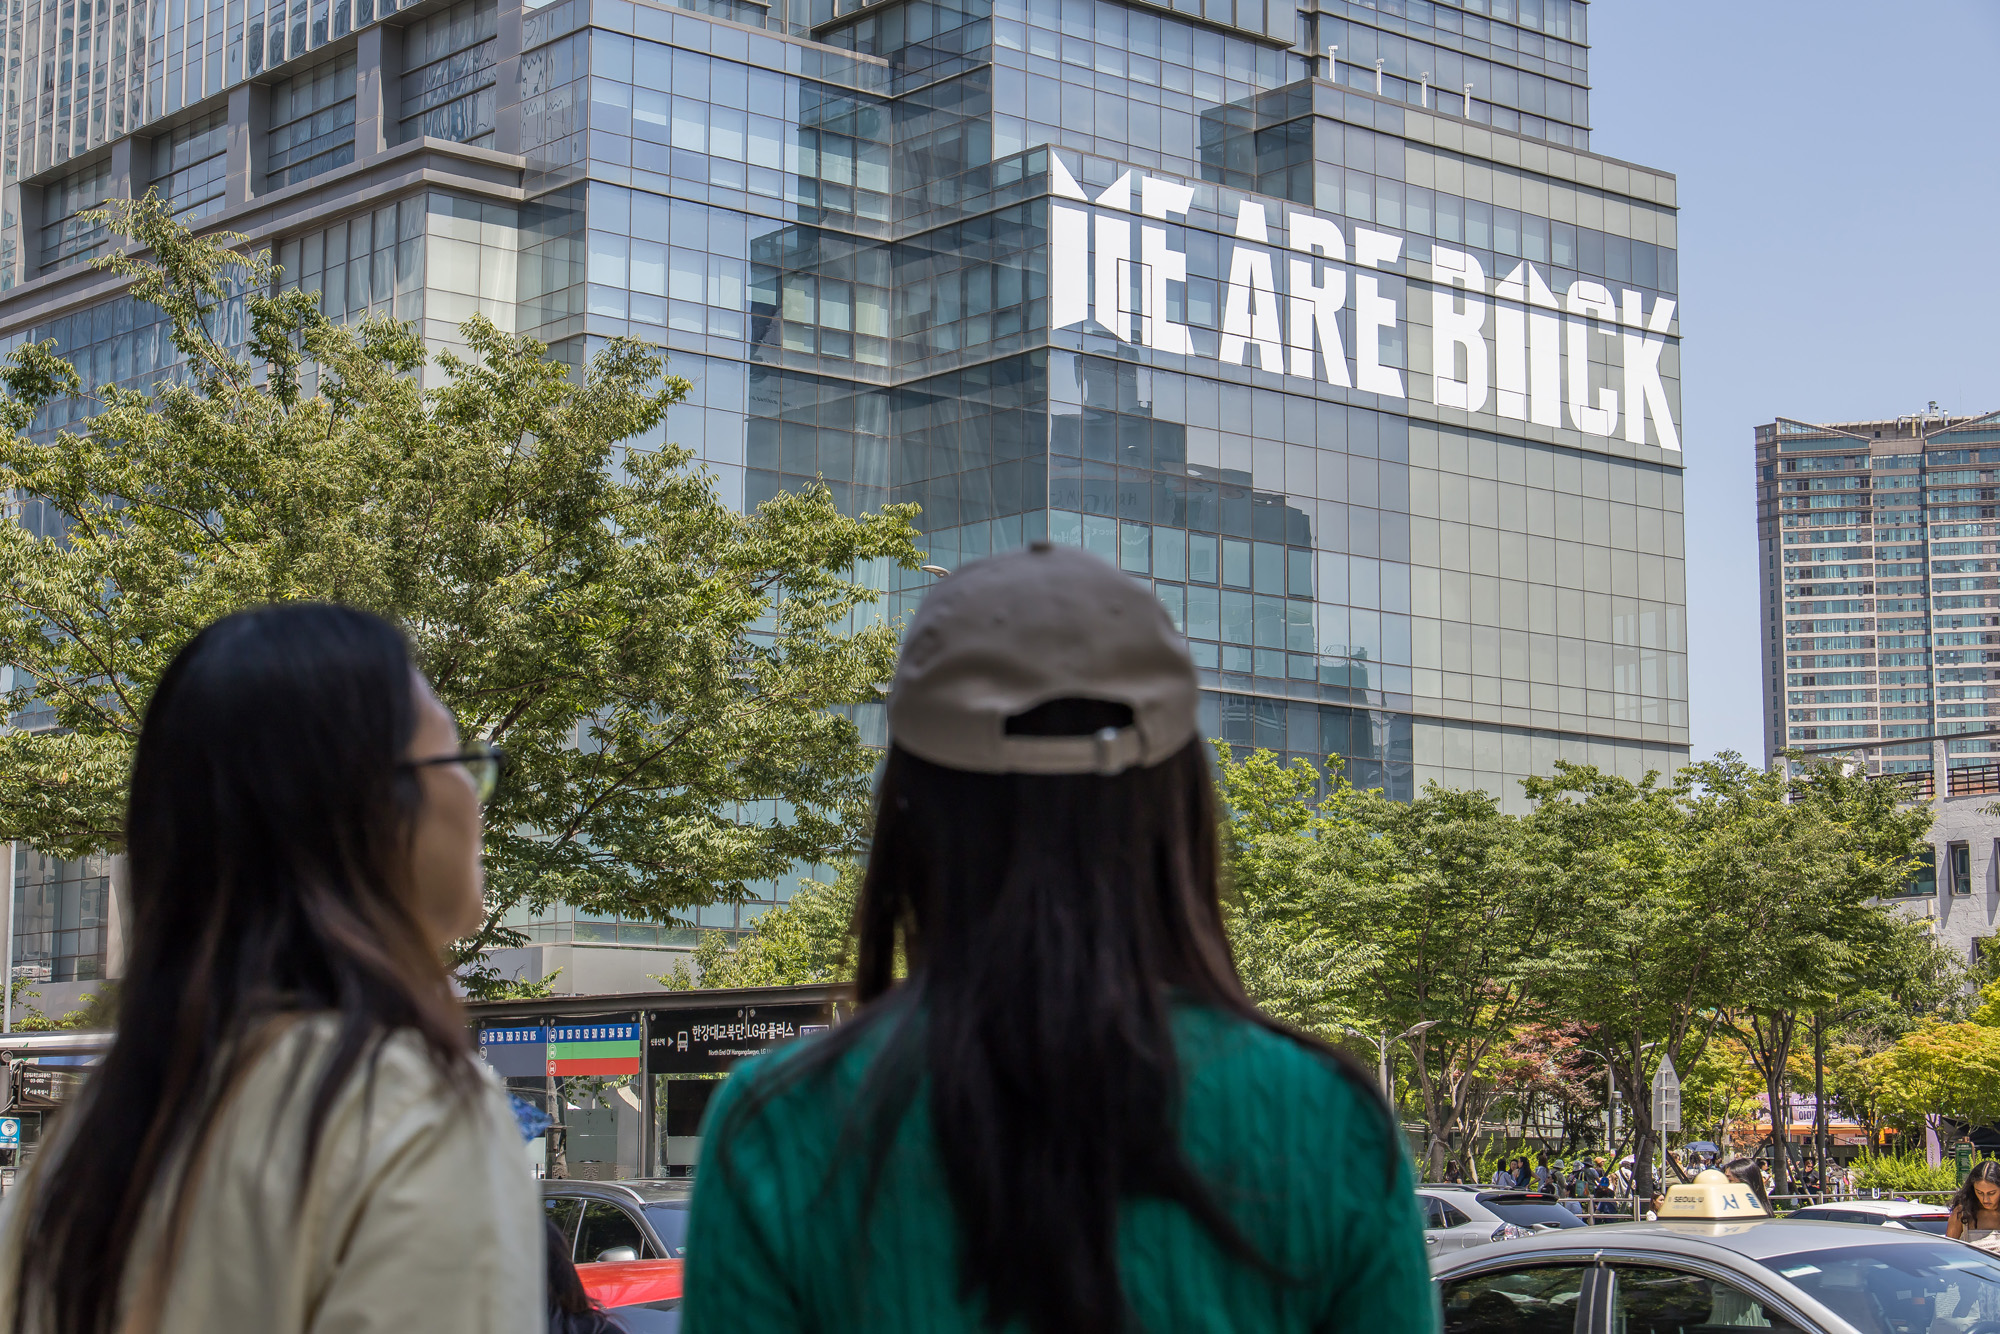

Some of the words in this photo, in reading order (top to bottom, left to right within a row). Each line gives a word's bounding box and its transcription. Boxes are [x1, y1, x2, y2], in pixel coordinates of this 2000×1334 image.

[1051, 149, 1195, 354] WE
[1219, 199, 1406, 398] ARE
[1430, 244, 1682, 452] BACK
